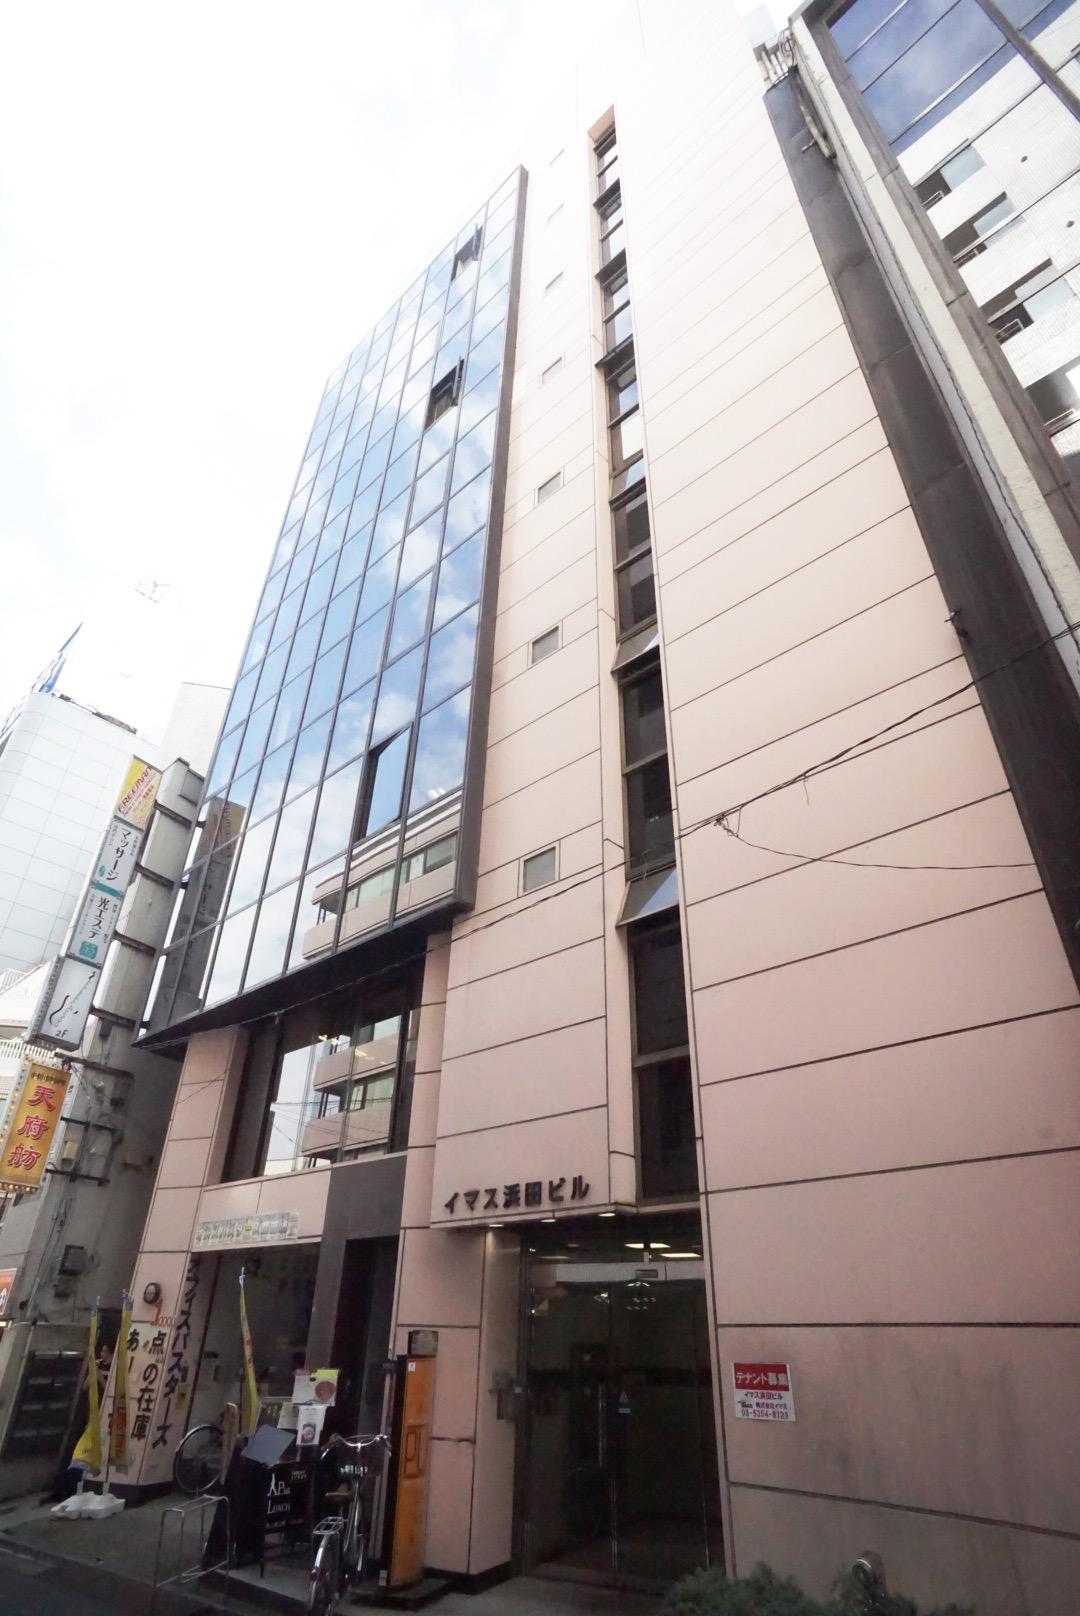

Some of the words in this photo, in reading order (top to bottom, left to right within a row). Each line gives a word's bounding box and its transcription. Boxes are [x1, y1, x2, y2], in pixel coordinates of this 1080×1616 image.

[105, 828, 132, 881] マッサージ
[7, 1085, 57, 1171] 天府舫
[131, 1330, 167, 1442] 点の在庫
[736, 1372, 789, 1386] テナント募集
